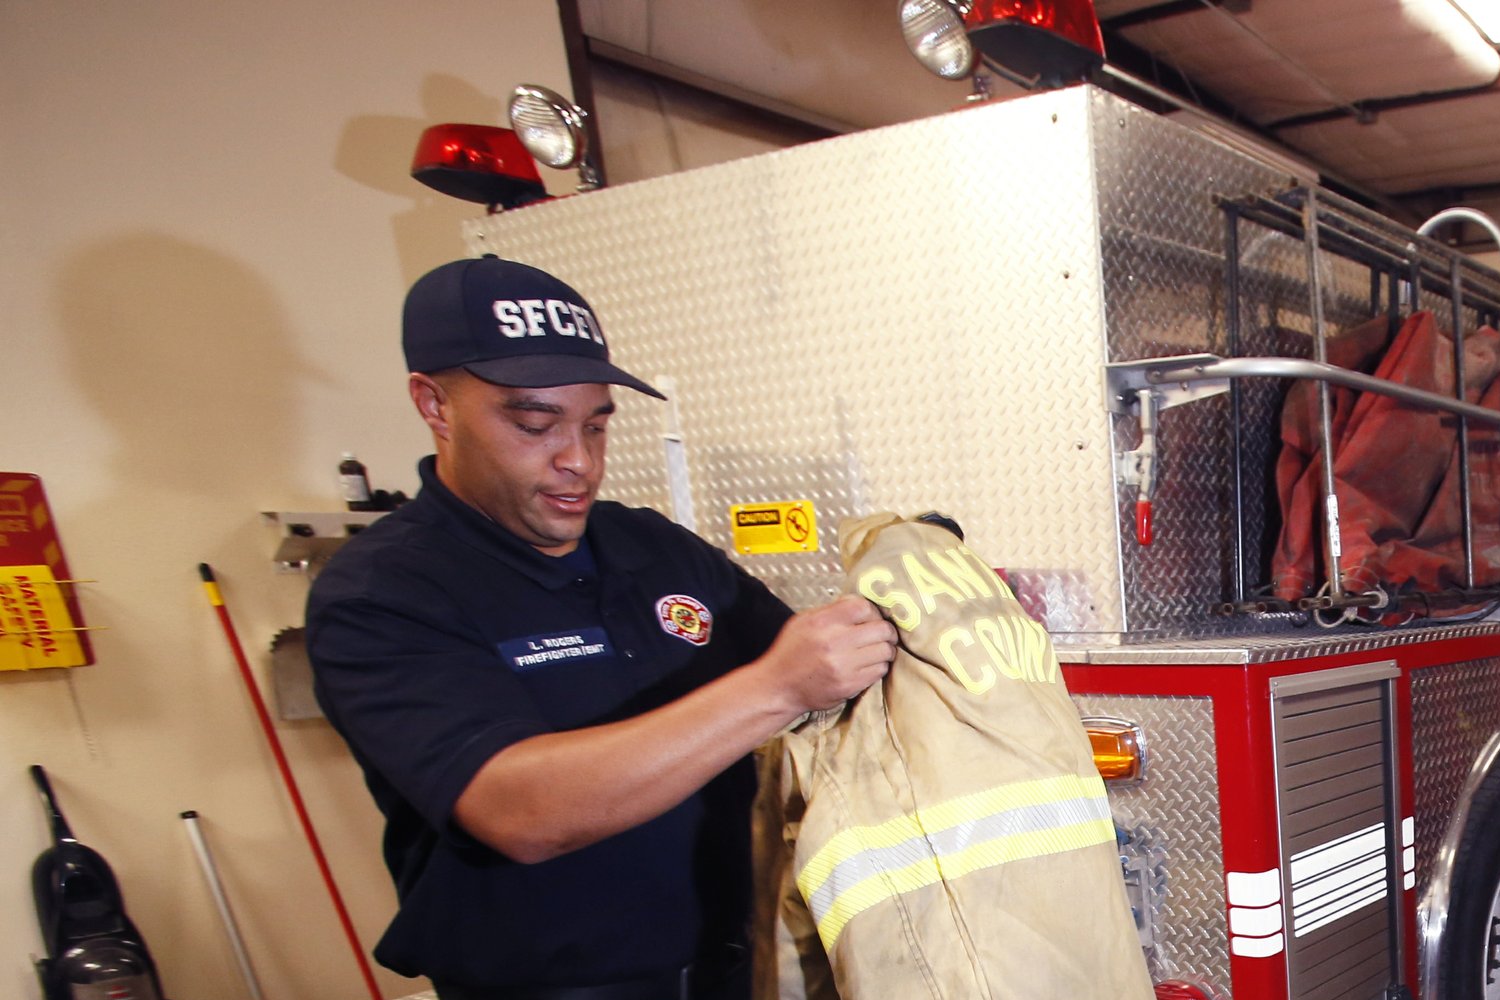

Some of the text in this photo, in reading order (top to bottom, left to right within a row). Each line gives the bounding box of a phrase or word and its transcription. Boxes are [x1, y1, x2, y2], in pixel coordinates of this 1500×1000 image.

[859, 545, 1016, 632] SANT
[14, 575, 58, 657] MATERIAL
[541, 635, 585, 649] ROGERS
[514, 643, 605, 667] FIREFIGHTER/EMT
